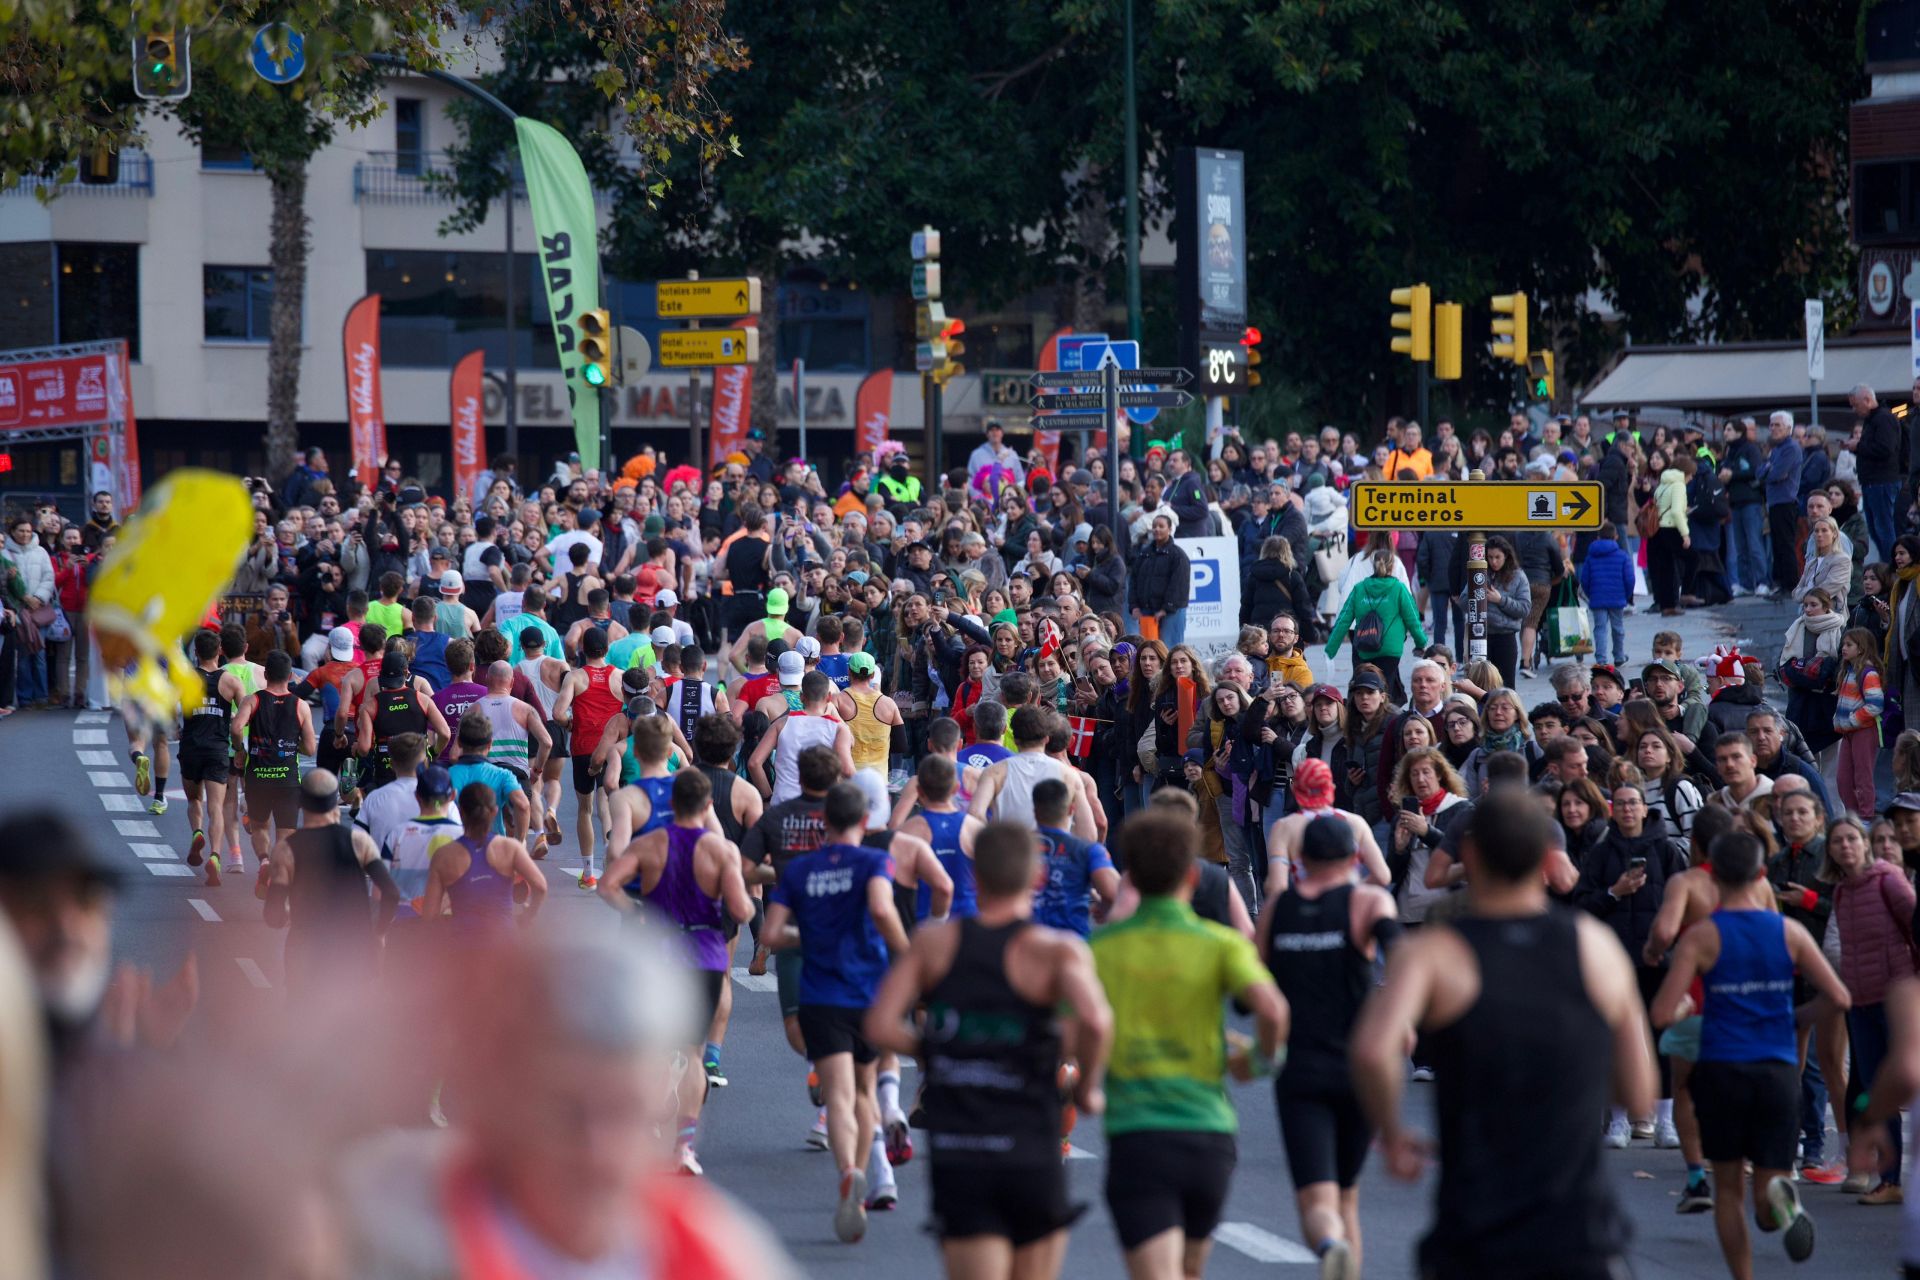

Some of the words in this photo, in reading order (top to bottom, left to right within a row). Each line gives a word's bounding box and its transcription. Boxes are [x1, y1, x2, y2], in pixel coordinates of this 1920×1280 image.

[660, 286, 690, 296] hoteles
[692, 286, 711, 295] zona
[660, 301, 682, 312] Este
[662, 338, 682, 347] Hotel
[352, 341, 376, 414] Vitality
[1045, 417, 1068, 425] CENTRO
[456, 396, 480, 465] Vitality
[1364, 488, 1456, 504] Terminal
[1364, 506, 1464, 522] Cruceros
[1189, 563, 1214, 600] P
[1190, 604, 1219, 612] rincipal
[1196, 616, 1220, 628] 50m
[388, 703, 409, 712] GAGO
